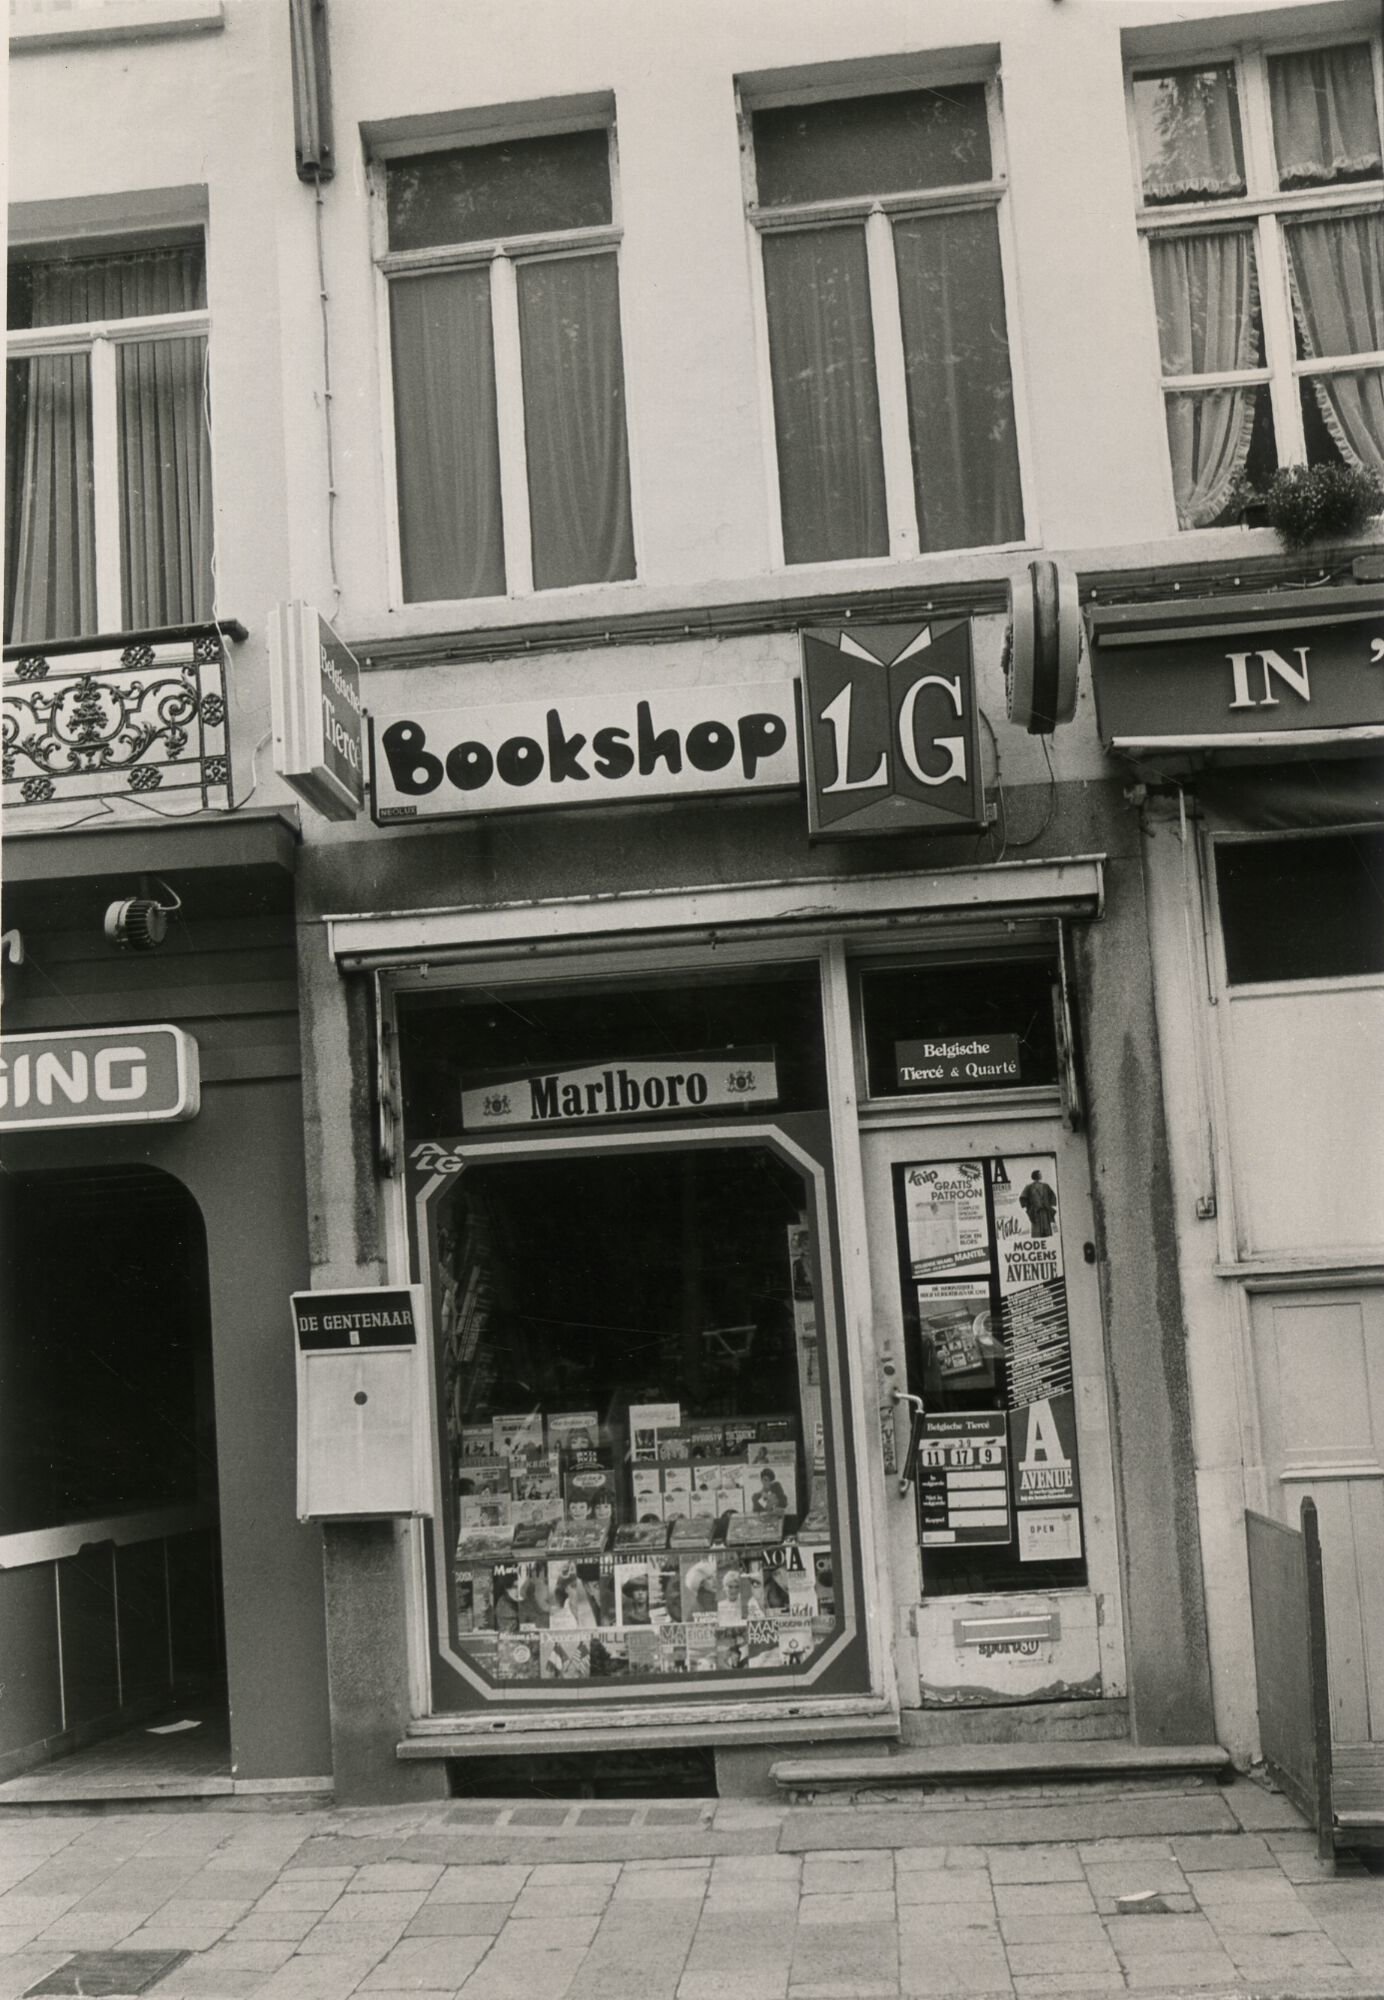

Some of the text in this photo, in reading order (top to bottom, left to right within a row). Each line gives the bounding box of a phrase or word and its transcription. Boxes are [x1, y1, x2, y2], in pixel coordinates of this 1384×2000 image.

[1225, 647, 1311, 707] IN
[382, 700, 787, 796] Bookshop
[923, 1041, 991, 1058] Belgische
[0, 1046, 148, 1108] ING
[900, 1060, 1017, 1081] Tiercé & Quarté
[528, 1070, 708, 1120] Marlboro
[931, 1189, 982, 1201] PATROON
[934, 1180, 972, 1191] GRATIS
[954, 1249, 986, 1261] MANTEL
[1013, 1240, 1047, 1251] MODE
[1004, 1251, 1057, 1263] VOLGENS
[1006, 1262, 1058, 1282] AVENUE
[299, 1310, 413, 1332] DE GENTENAAR
[1018, 1398, 1072, 1471] A
[927, 1448, 992, 1466] 11 17 9
[1020, 1468, 1073, 1490] AVENUE
[1030, 1524, 1054, 1534] OPEN
